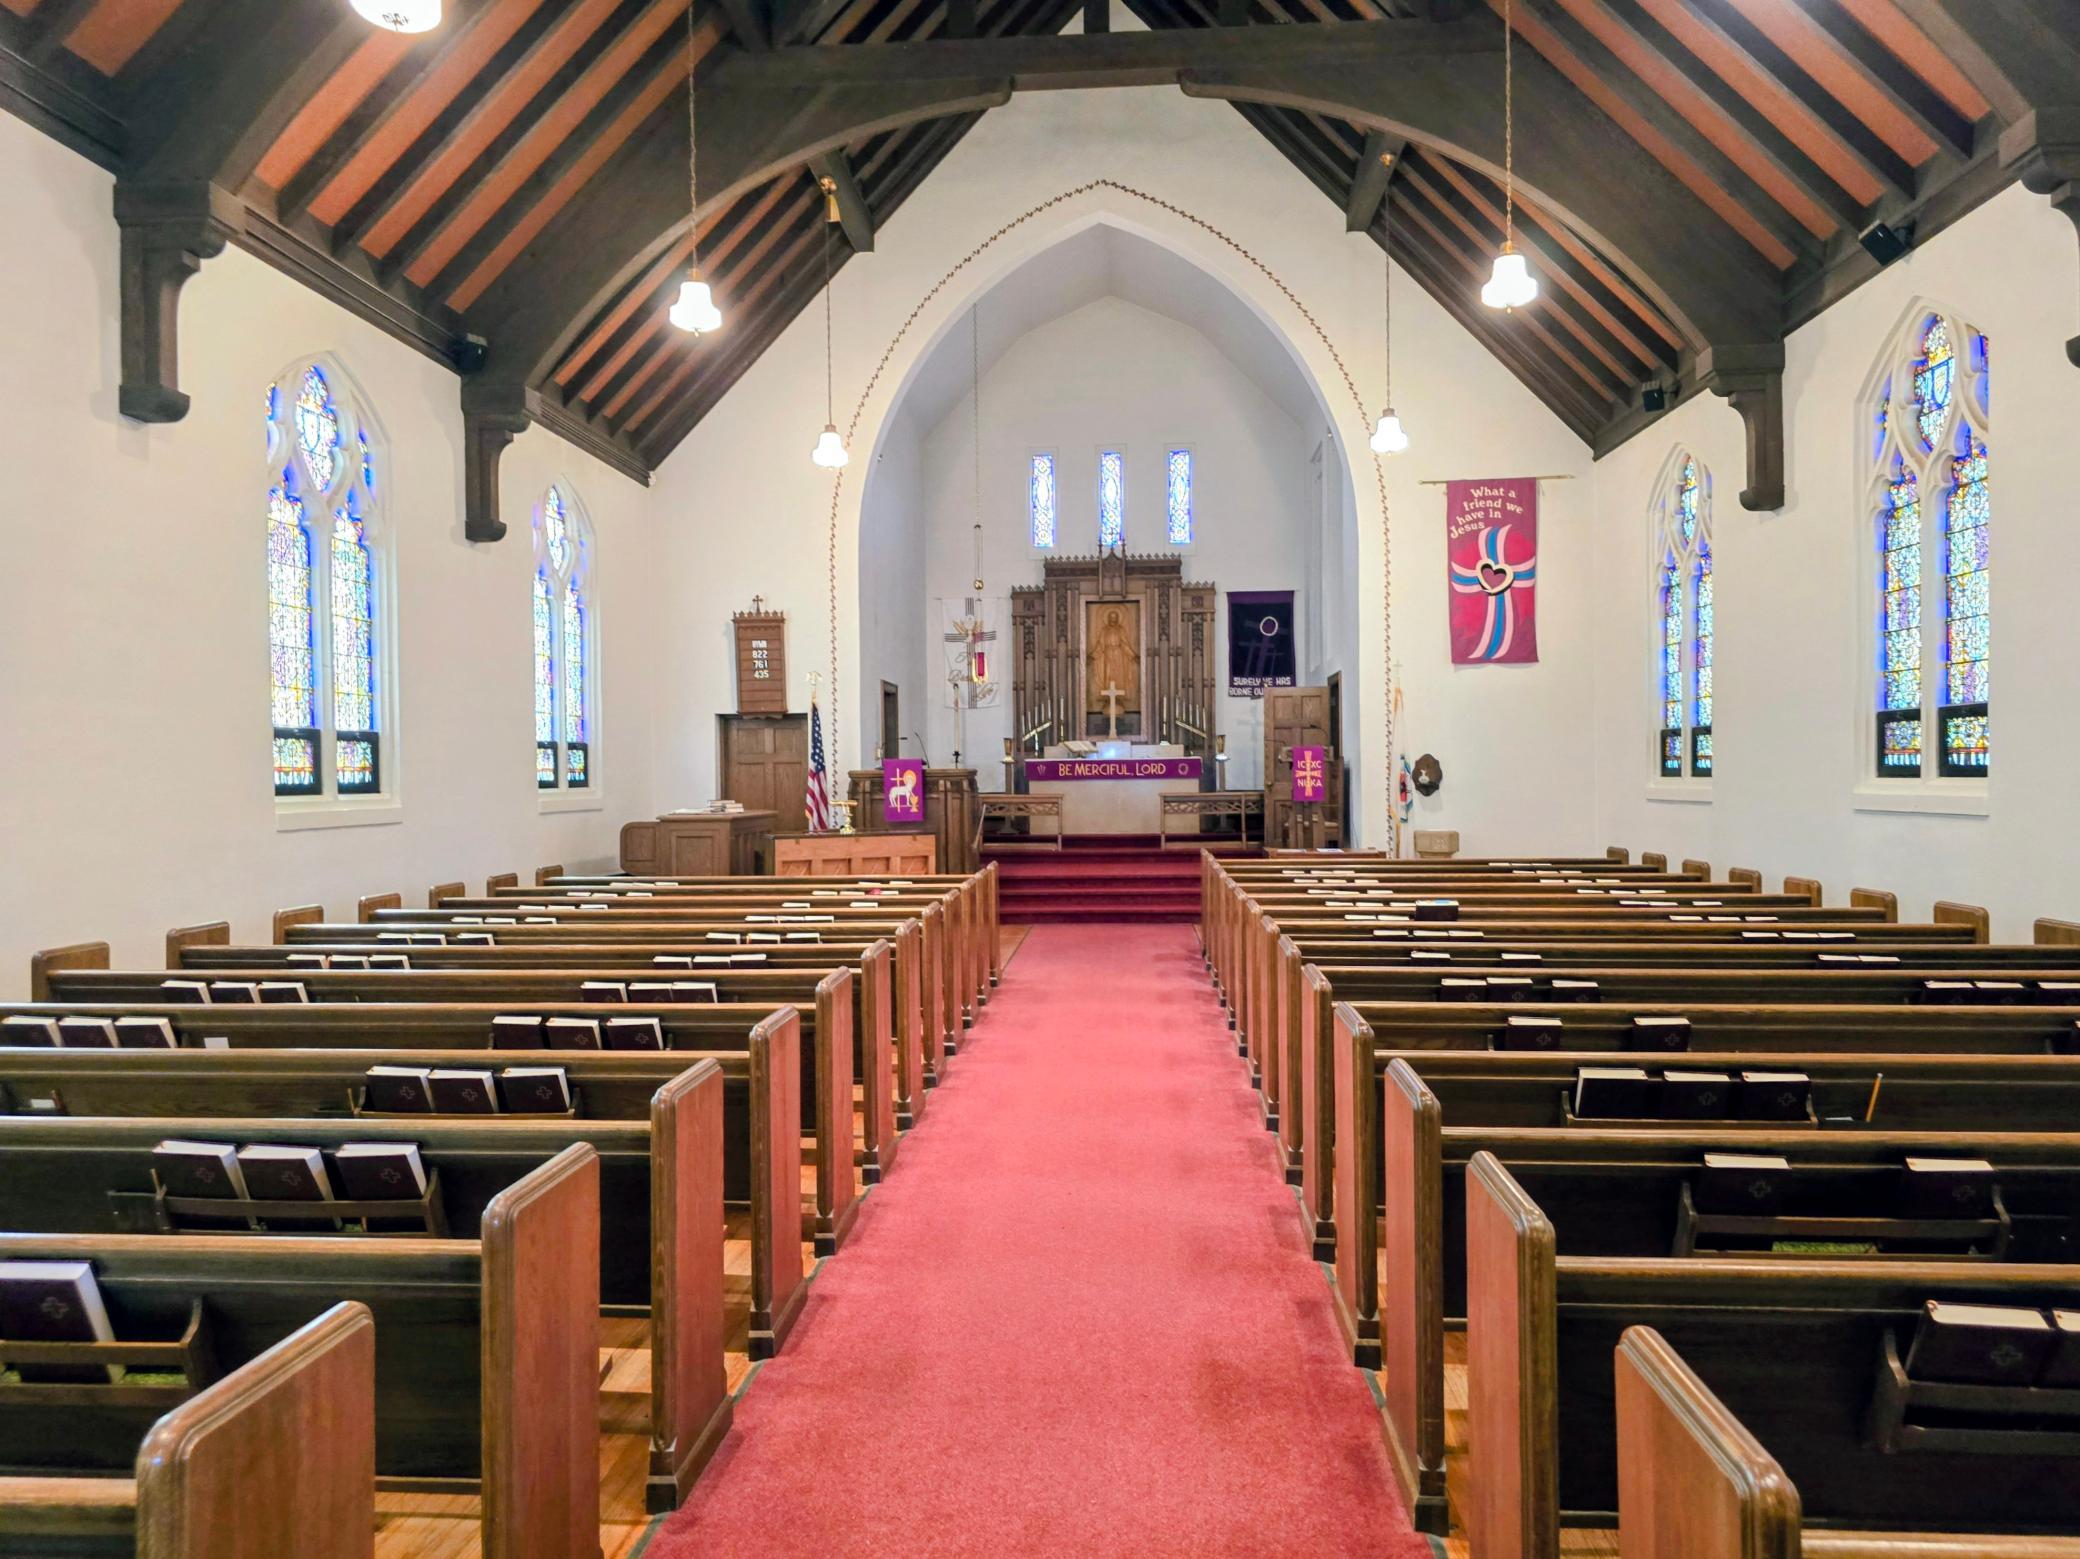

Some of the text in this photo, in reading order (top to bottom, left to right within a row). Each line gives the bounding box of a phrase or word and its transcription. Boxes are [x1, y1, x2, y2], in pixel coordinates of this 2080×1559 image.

[1470, 486, 1516, 498] What a
[1463, 499, 1523, 514] friend we
[1456, 508, 1502, 526] have in
[1450, 521, 1485, 539] Jesus
[752, 650, 768, 659] 822
[753, 660, 768, 669] 761
[1233, 677, 1261, 686] SURELY
[1276, 676, 1291, 686] HAS
[1229, 687, 1264, 696] BORNE OU
[1059, 763, 1072, 776] BE
